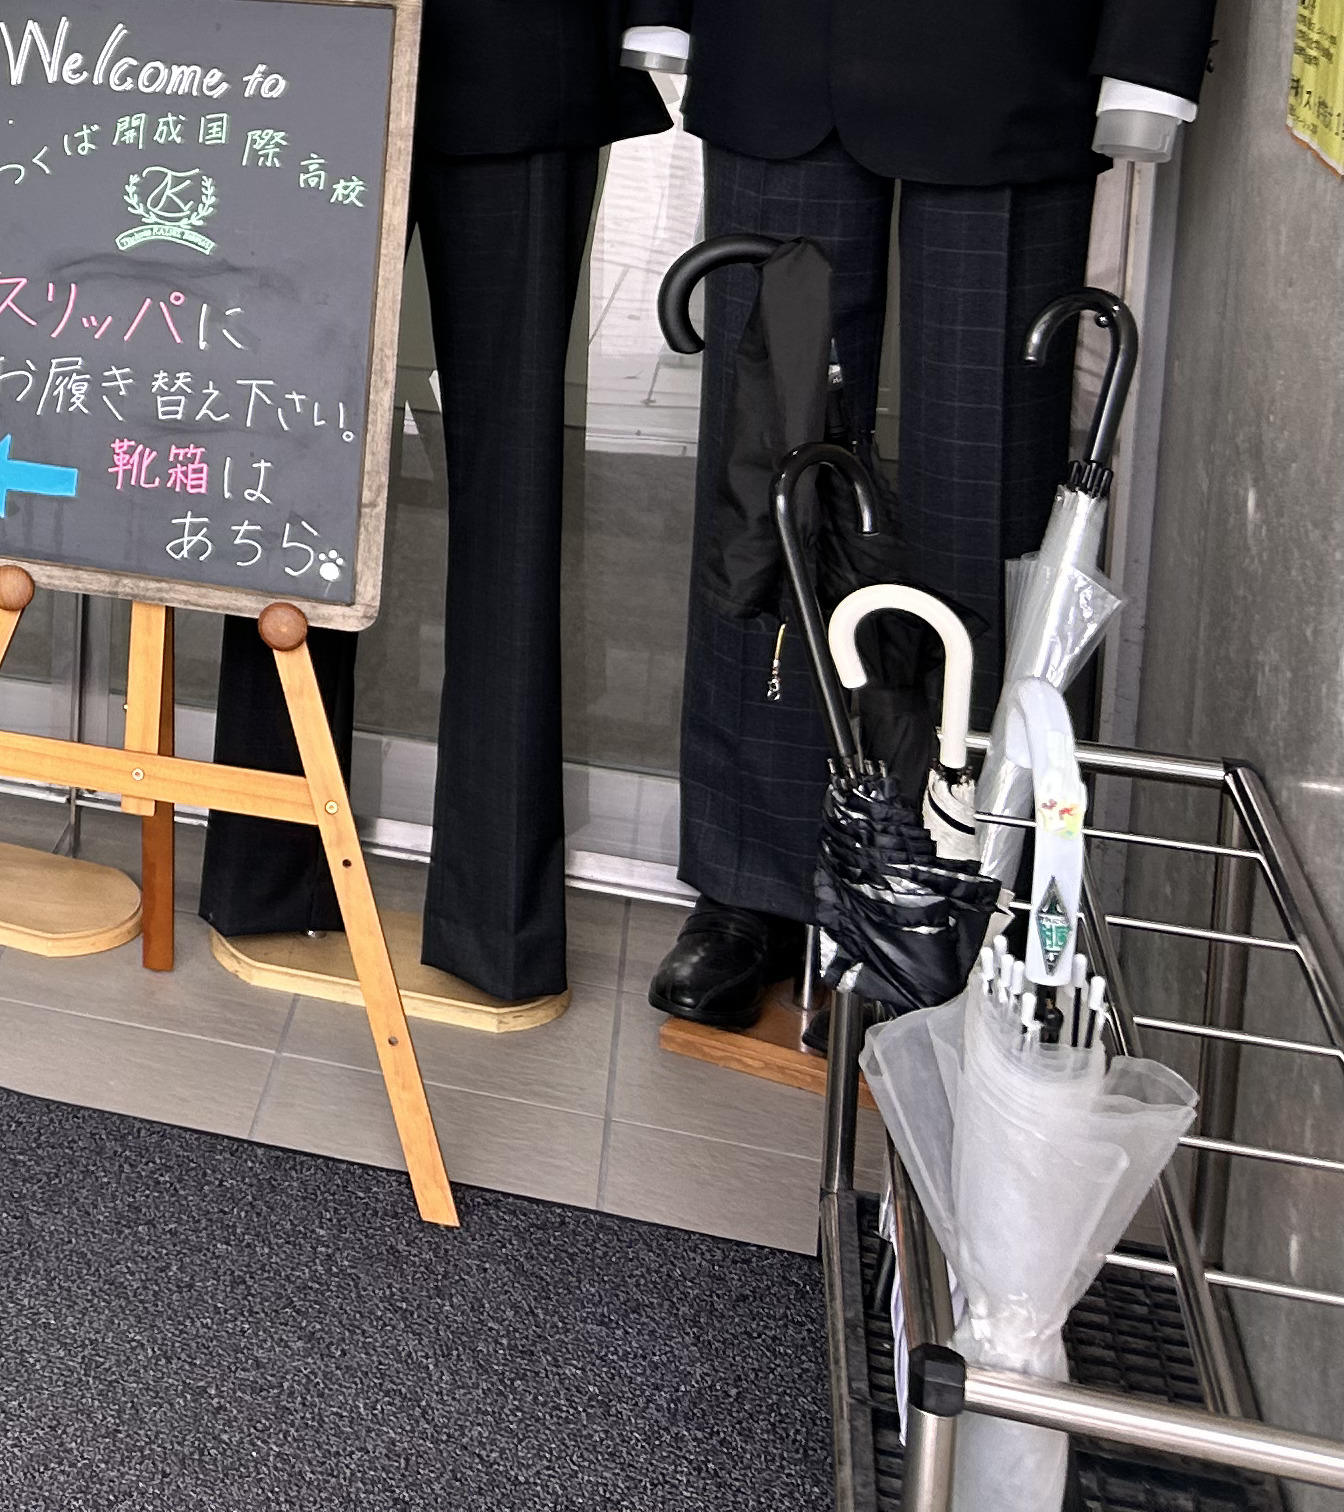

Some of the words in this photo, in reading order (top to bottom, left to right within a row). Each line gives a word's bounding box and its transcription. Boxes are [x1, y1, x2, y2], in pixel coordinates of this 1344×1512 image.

[241, 64, 287, 98] to
[108, 437, 273, 507] 靴箱は
[165, 509, 318, 576] あちら
